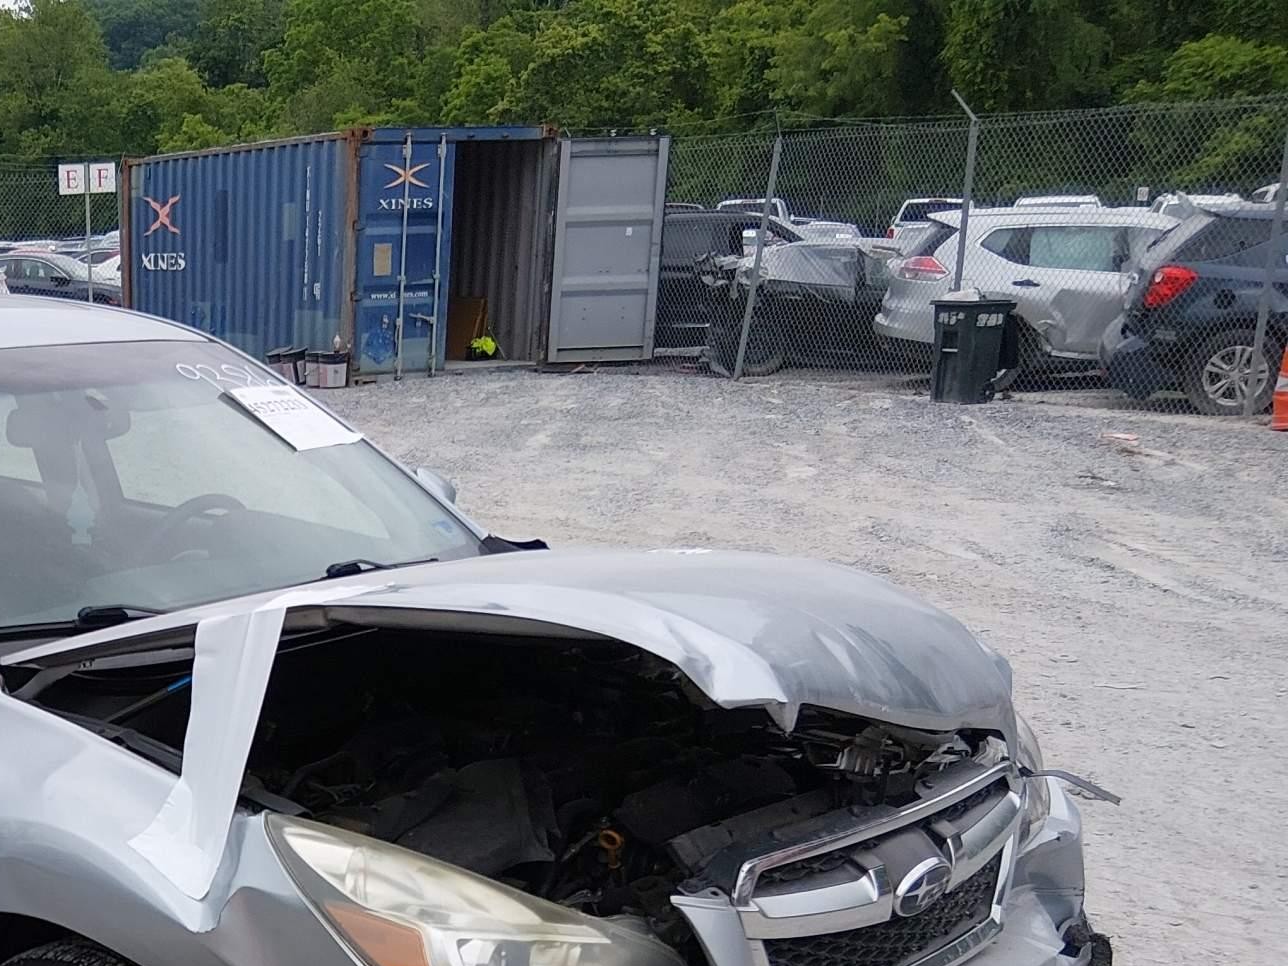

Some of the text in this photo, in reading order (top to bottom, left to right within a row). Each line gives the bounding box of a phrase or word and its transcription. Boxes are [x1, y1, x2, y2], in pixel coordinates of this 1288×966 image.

[65, 169, 79, 190] E
[96, 168, 109, 189] F
[377, 197, 433, 210] XINES
[141, 252, 186, 271] XINES
